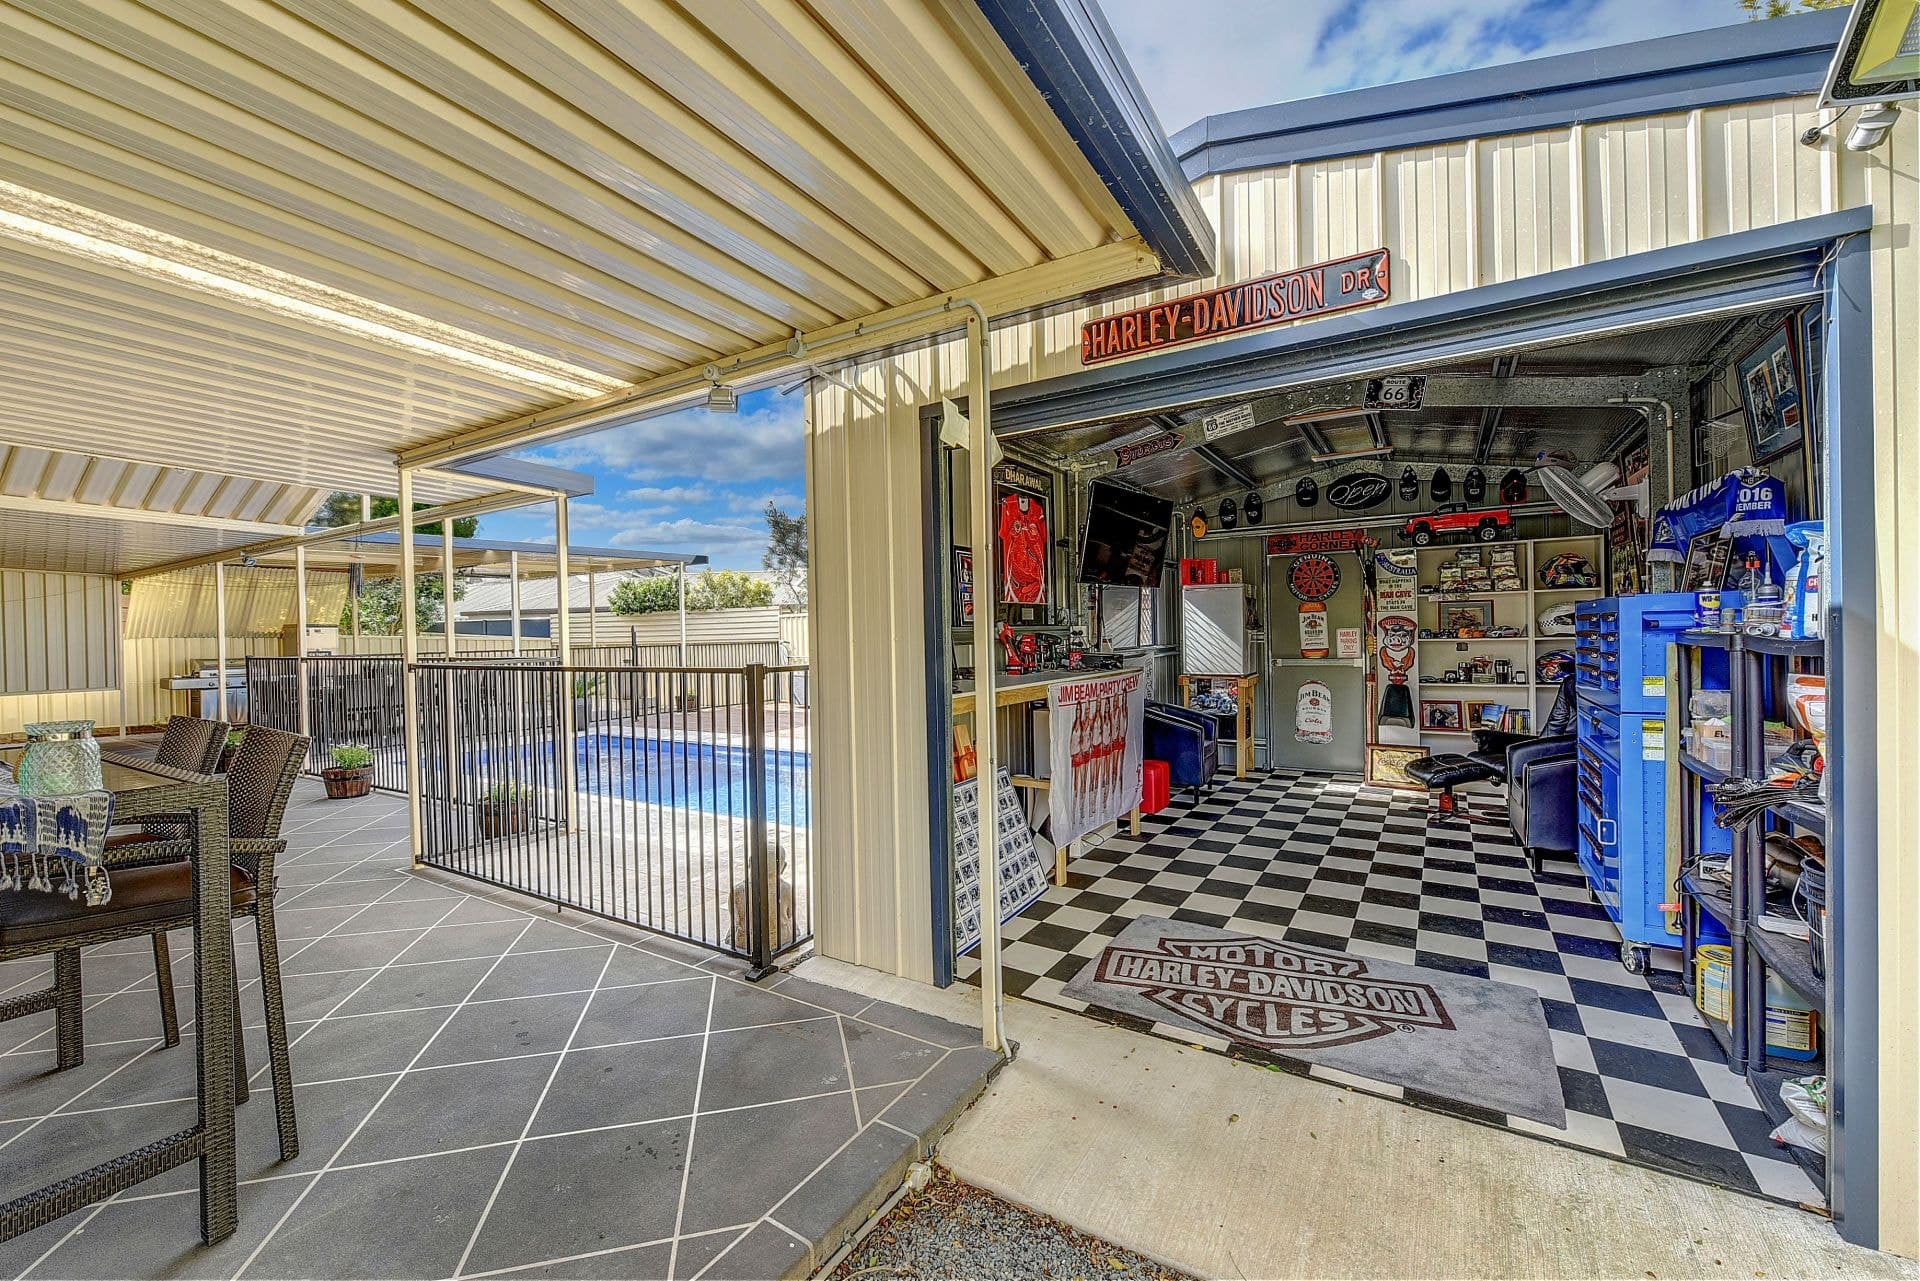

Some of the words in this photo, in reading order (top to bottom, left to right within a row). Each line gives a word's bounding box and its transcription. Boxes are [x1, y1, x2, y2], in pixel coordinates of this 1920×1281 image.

[1091, 268, 1325, 358] HARLEY-DAVIDSON
[1341, 267, 1371, 294] DR
[1383, 387, 1404, 400] 66
[1330, 480, 1387, 505] Open
[1300, 530, 1360, 541] HARLEY
[1300, 540, 1357, 551] CORNER
[1395, 590, 1412, 598] CAVE
[1058, 685, 1073, 703] JIM
[1074, 682, 1098, 700] BEAM
[1099, 679, 1120, 694] PARTY
[1122, 675, 1140, 690] CREW
[1299, 691, 1311, 702] JIM
[1189, 945, 1336, 976] MOTOR
[1119, 956, 1421, 1015] HARLEY-DAVIDSON
[1181, 992, 1349, 1036] CYCLES
